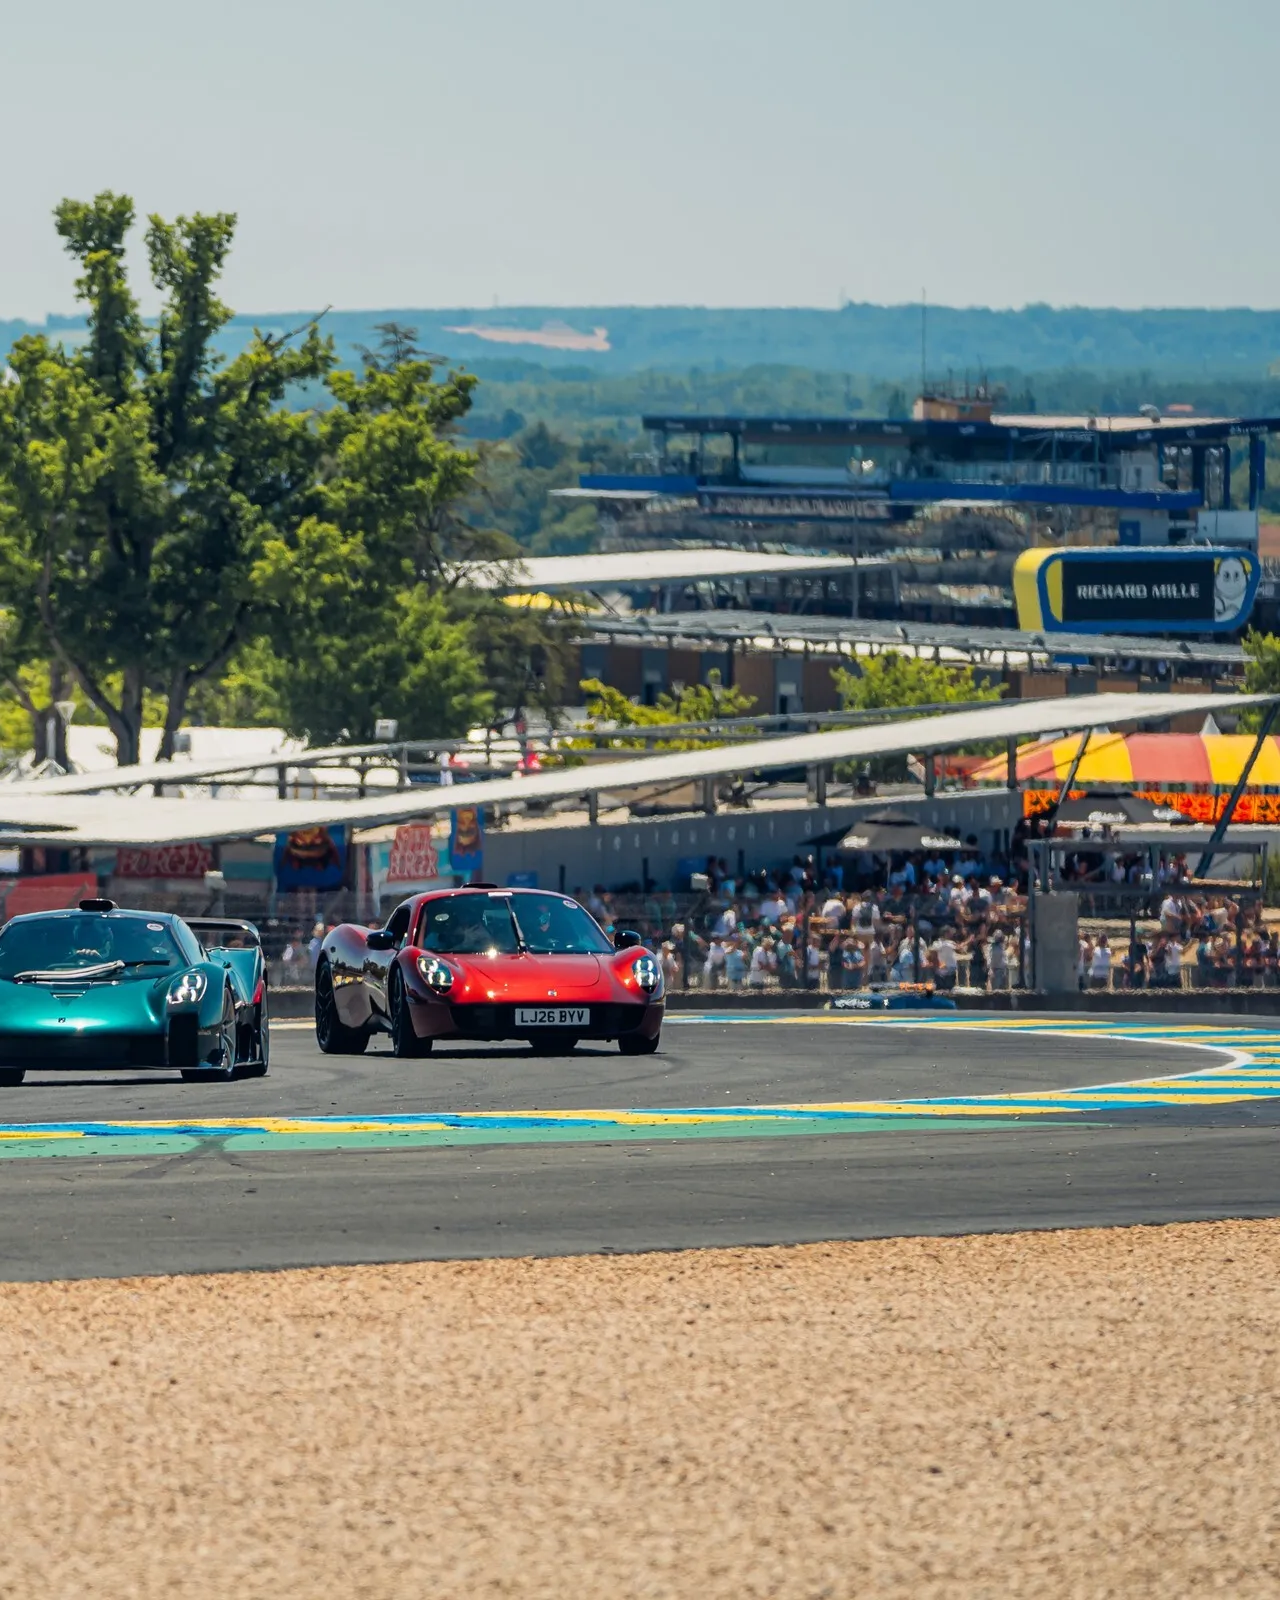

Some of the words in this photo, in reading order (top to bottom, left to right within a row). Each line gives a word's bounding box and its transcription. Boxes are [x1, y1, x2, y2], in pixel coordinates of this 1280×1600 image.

[1076, 584, 1148, 600] RICHARD
[1151, 583, 1200, 599] MILLE
[521, 1010, 556, 1024] LJ26
[559, 1010, 585, 1024] BYV
